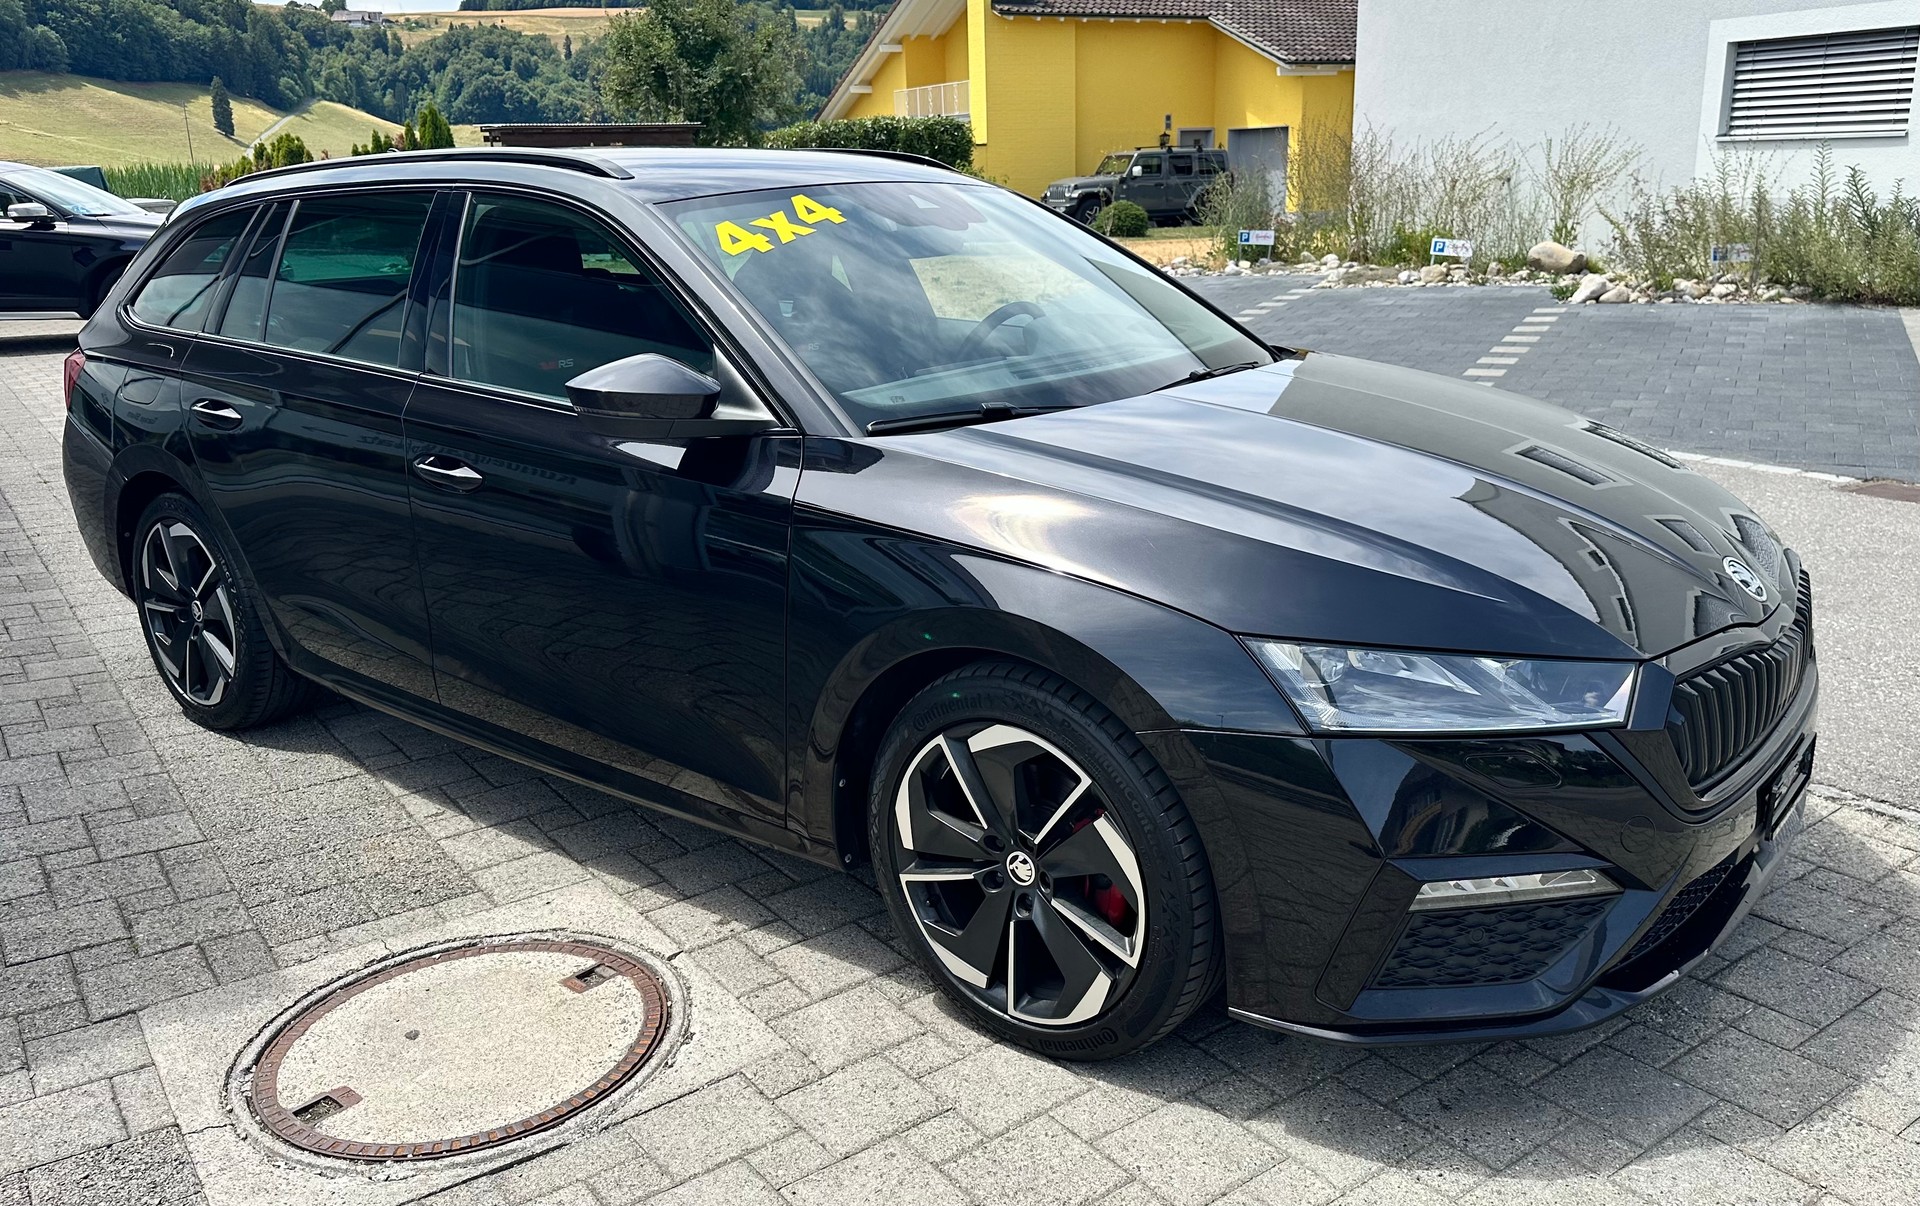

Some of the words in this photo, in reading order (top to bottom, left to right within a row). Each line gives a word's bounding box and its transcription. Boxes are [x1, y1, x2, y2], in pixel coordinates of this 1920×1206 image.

[715, 194, 847, 256] 4x4
[558, 358, 574, 369] RS
[912, 692, 984, 733] Continental
[1038, 1027, 1119, 1051] Continental
